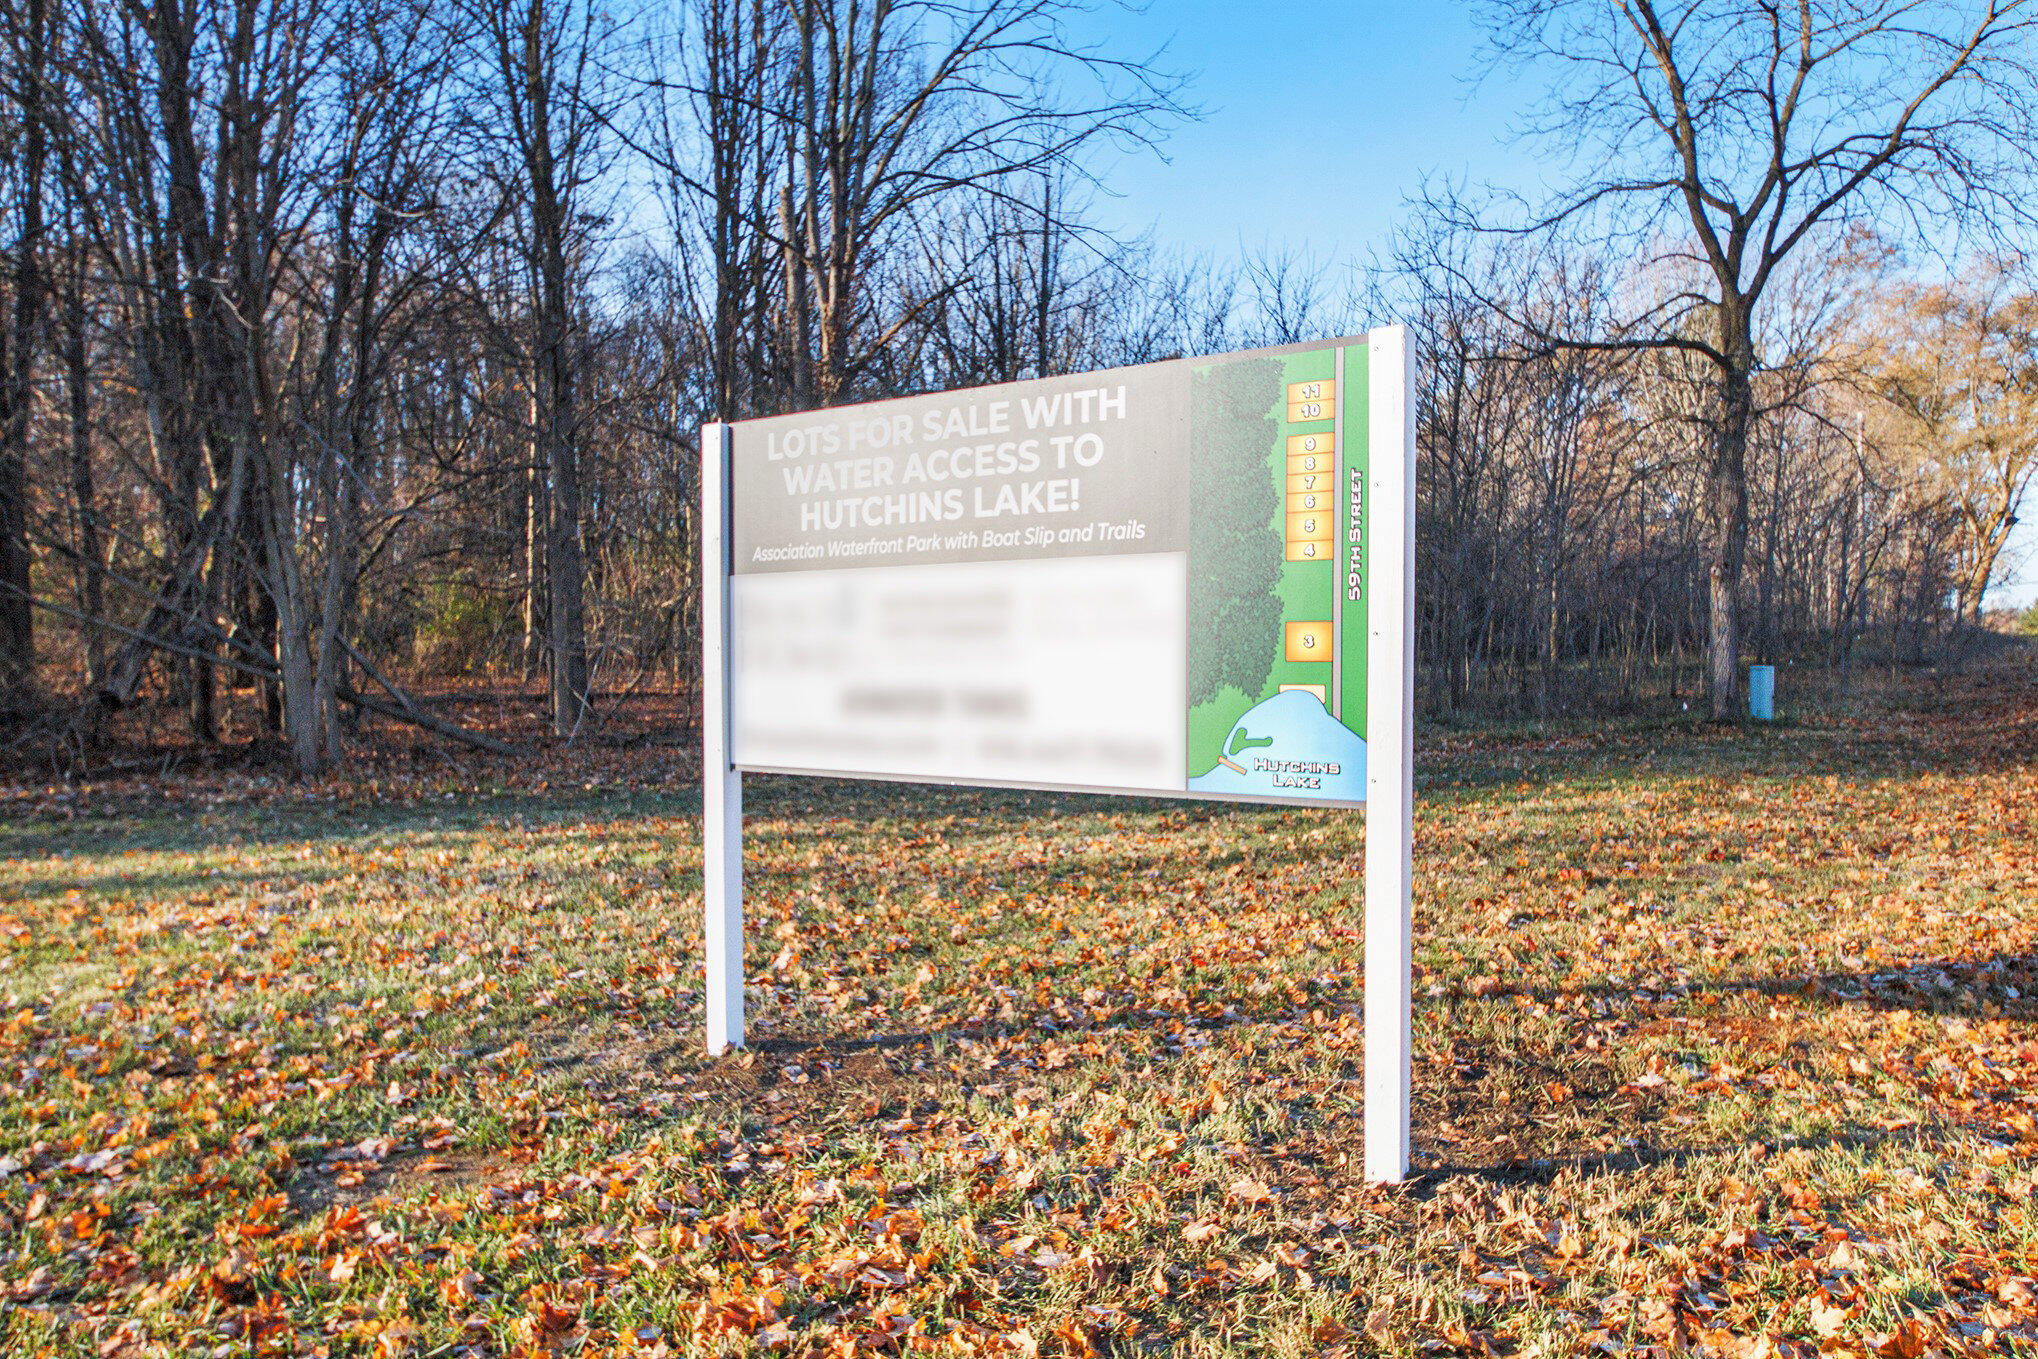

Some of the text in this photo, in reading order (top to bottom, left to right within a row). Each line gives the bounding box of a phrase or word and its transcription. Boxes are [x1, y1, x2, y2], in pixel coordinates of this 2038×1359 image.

[1302, 384, 1321, 398] 11
[1301, 403, 1321, 418] 10
[768, 385, 1127, 462] LOTS FOR SALE WITH
[1305, 437, 1316, 451] 9
[783, 433, 1105, 496] WATER ACCESS TO
[1305, 457, 1316, 470] 8
[1305, 476, 1315, 489] 7
[800, 477, 1080, 531] HUTCHINS LAKE!
[1305, 495, 1315, 509] 6
[1304, 519, 1315, 533] 5
[752, 519, 1146, 562] Association Waterfront Park with Boat Slip and Trails
[1348, 467, 1363, 600] 59TH STREET
[1304, 544, 1315, 557] 4
[1304, 634, 1315, 648] 3
[1273, 774, 1321, 789] LAKE
